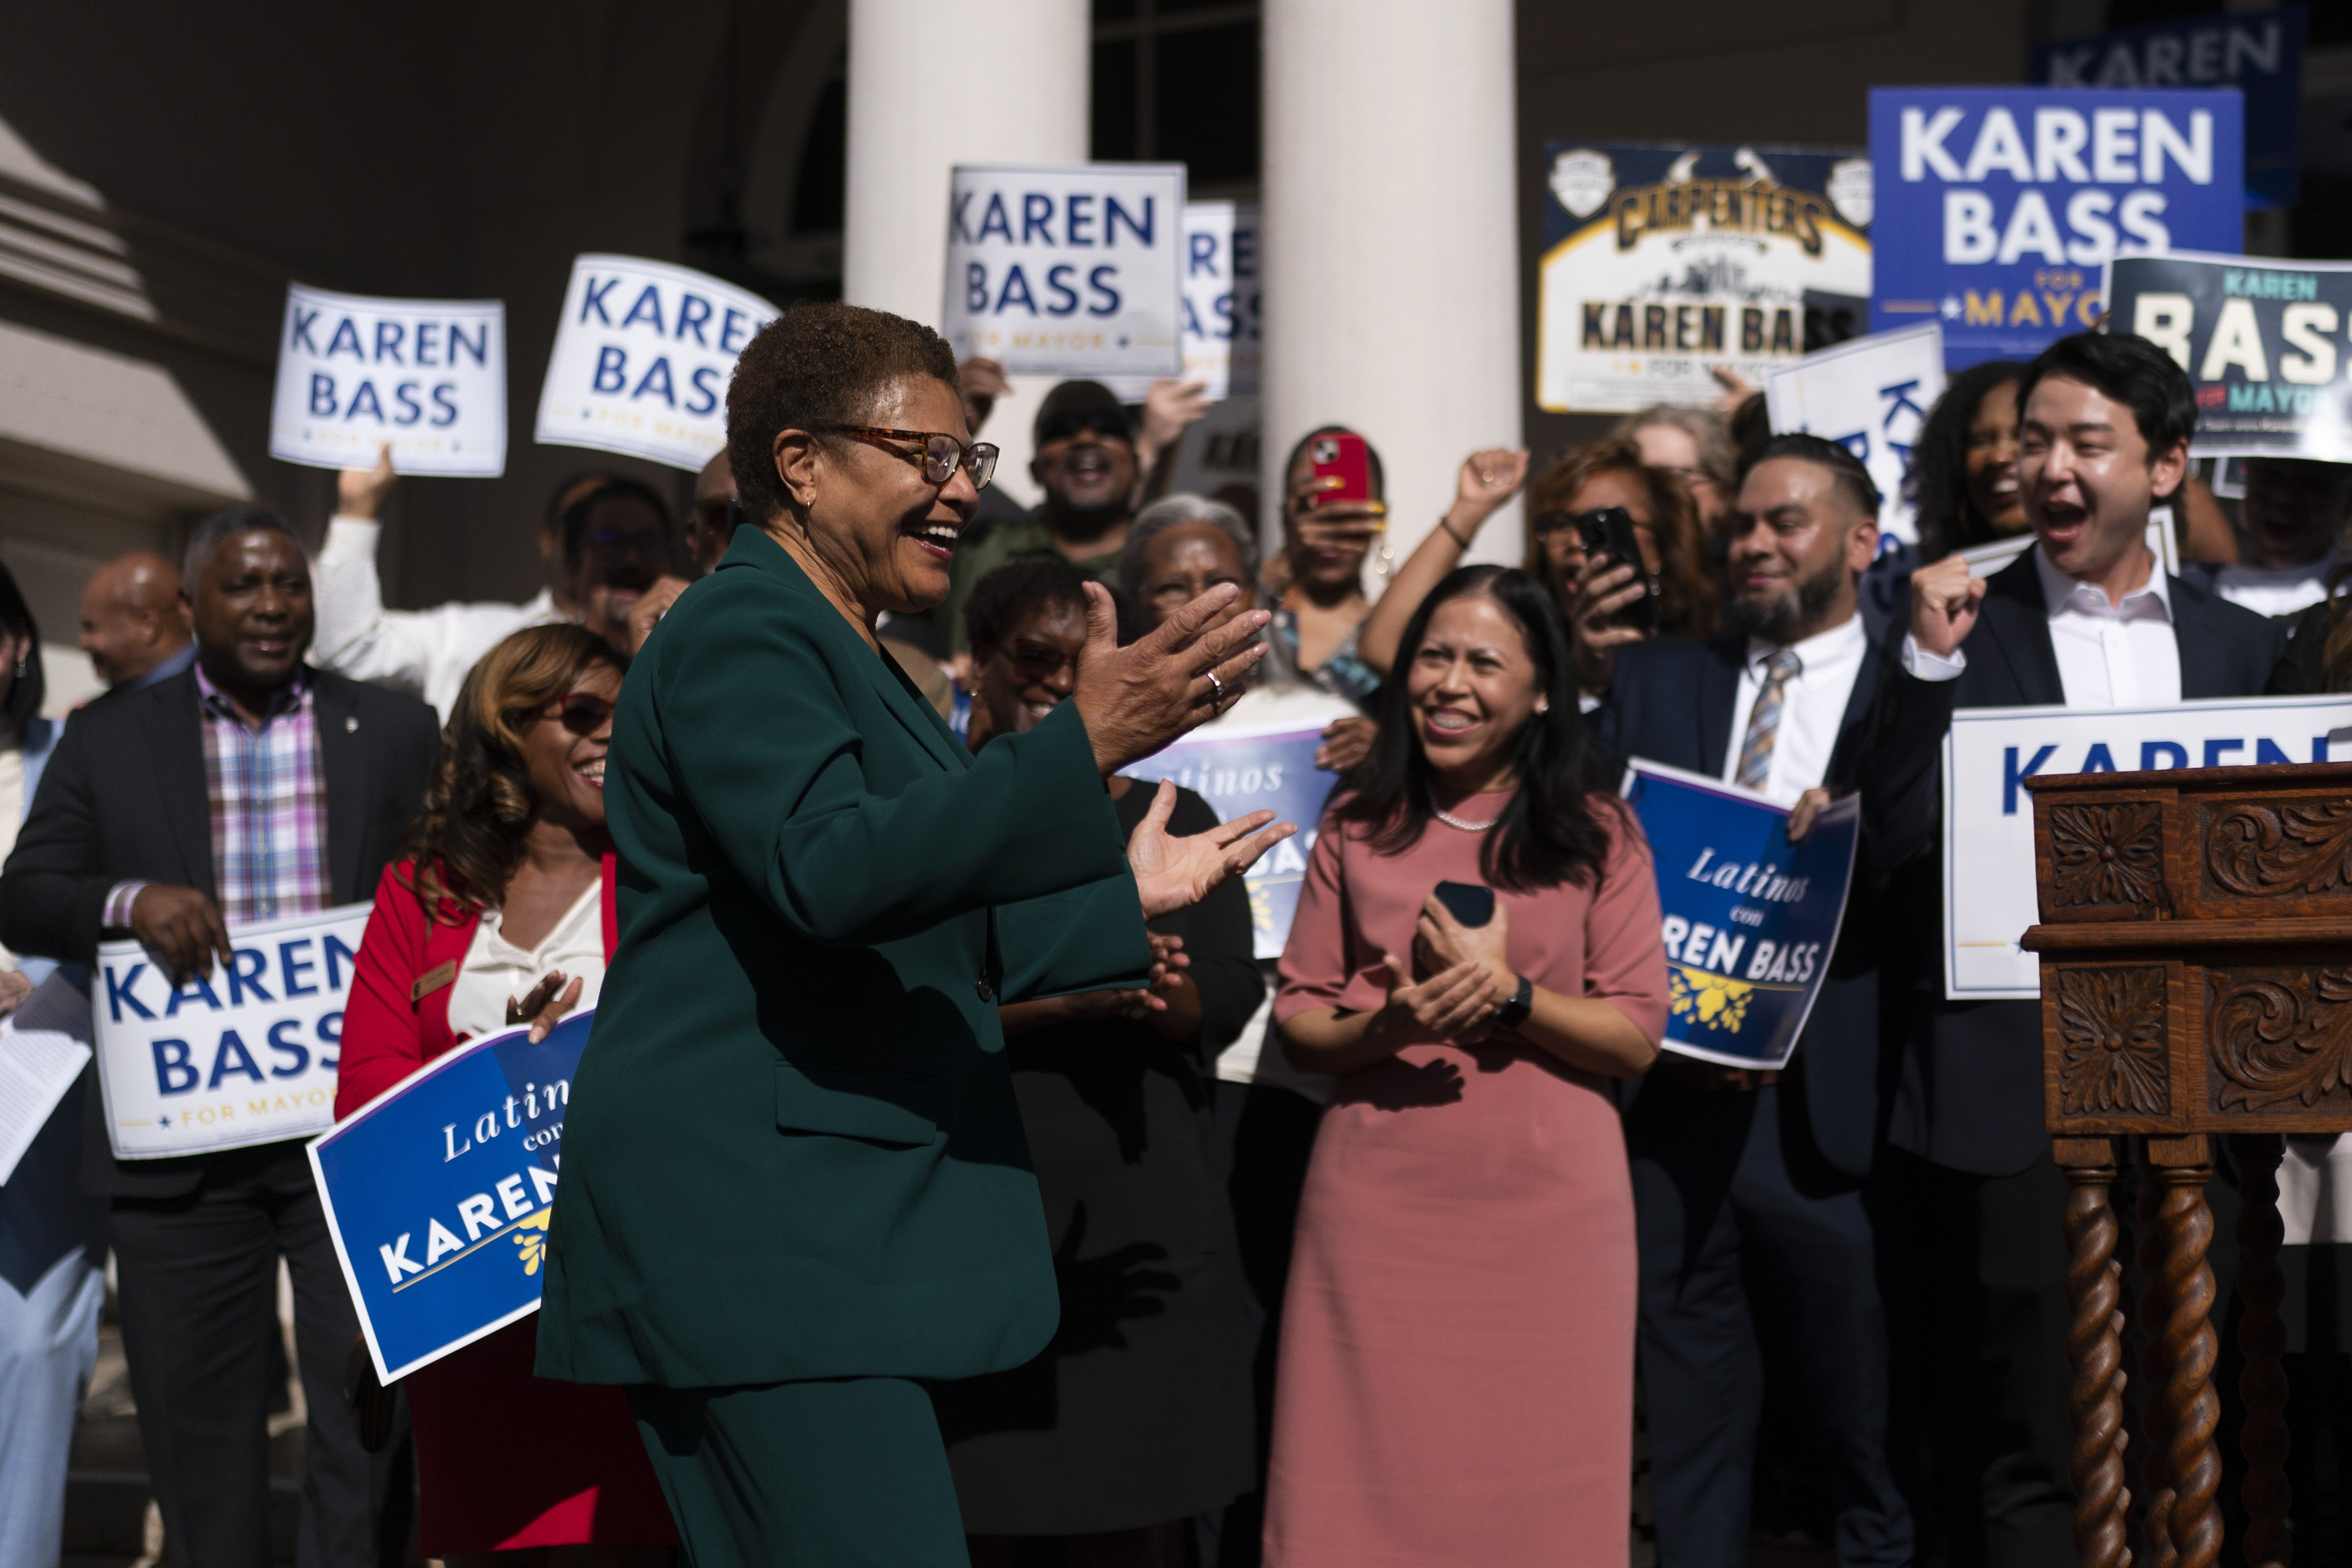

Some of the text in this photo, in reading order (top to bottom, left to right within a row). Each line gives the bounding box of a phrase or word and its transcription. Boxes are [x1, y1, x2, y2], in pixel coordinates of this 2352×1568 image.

[2048, 20, 2283, 89] KAREN
[1900, 105, 2213, 184] KAREN
[949, 191, 1155, 248] KAREN
[1943, 189, 2170, 266] BASS
[966, 262, 1121, 318] BASS
[1964, 288, 2105, 328] MAYO
[2034, 269, 2084, 291] FOR
[2223, 269, 2318, 301] KAREN
[289, 304, 488, 370] KAREN
[579, 276, 768, 358] KARE
[1582, 302, 1724, 351] KAREN
[2133, 291, 2352, 385] BAS
[307, 370, 459, 428] BASS
[590, 344, 730, 420] BAS
[653, 419, 728, 452] MAYO
[1686, 846, 1810, 903] Latinos
[1729, 905, 1764, 927] con
[103, 934, 356, 1025] KAREN
[1662, 914, 1821, 984] REN BASS
[151, 1010, 345, 1099] BASS
[180, 1102, 236, 1128] FOR
[442, 1078, 569, 1163] Latin
